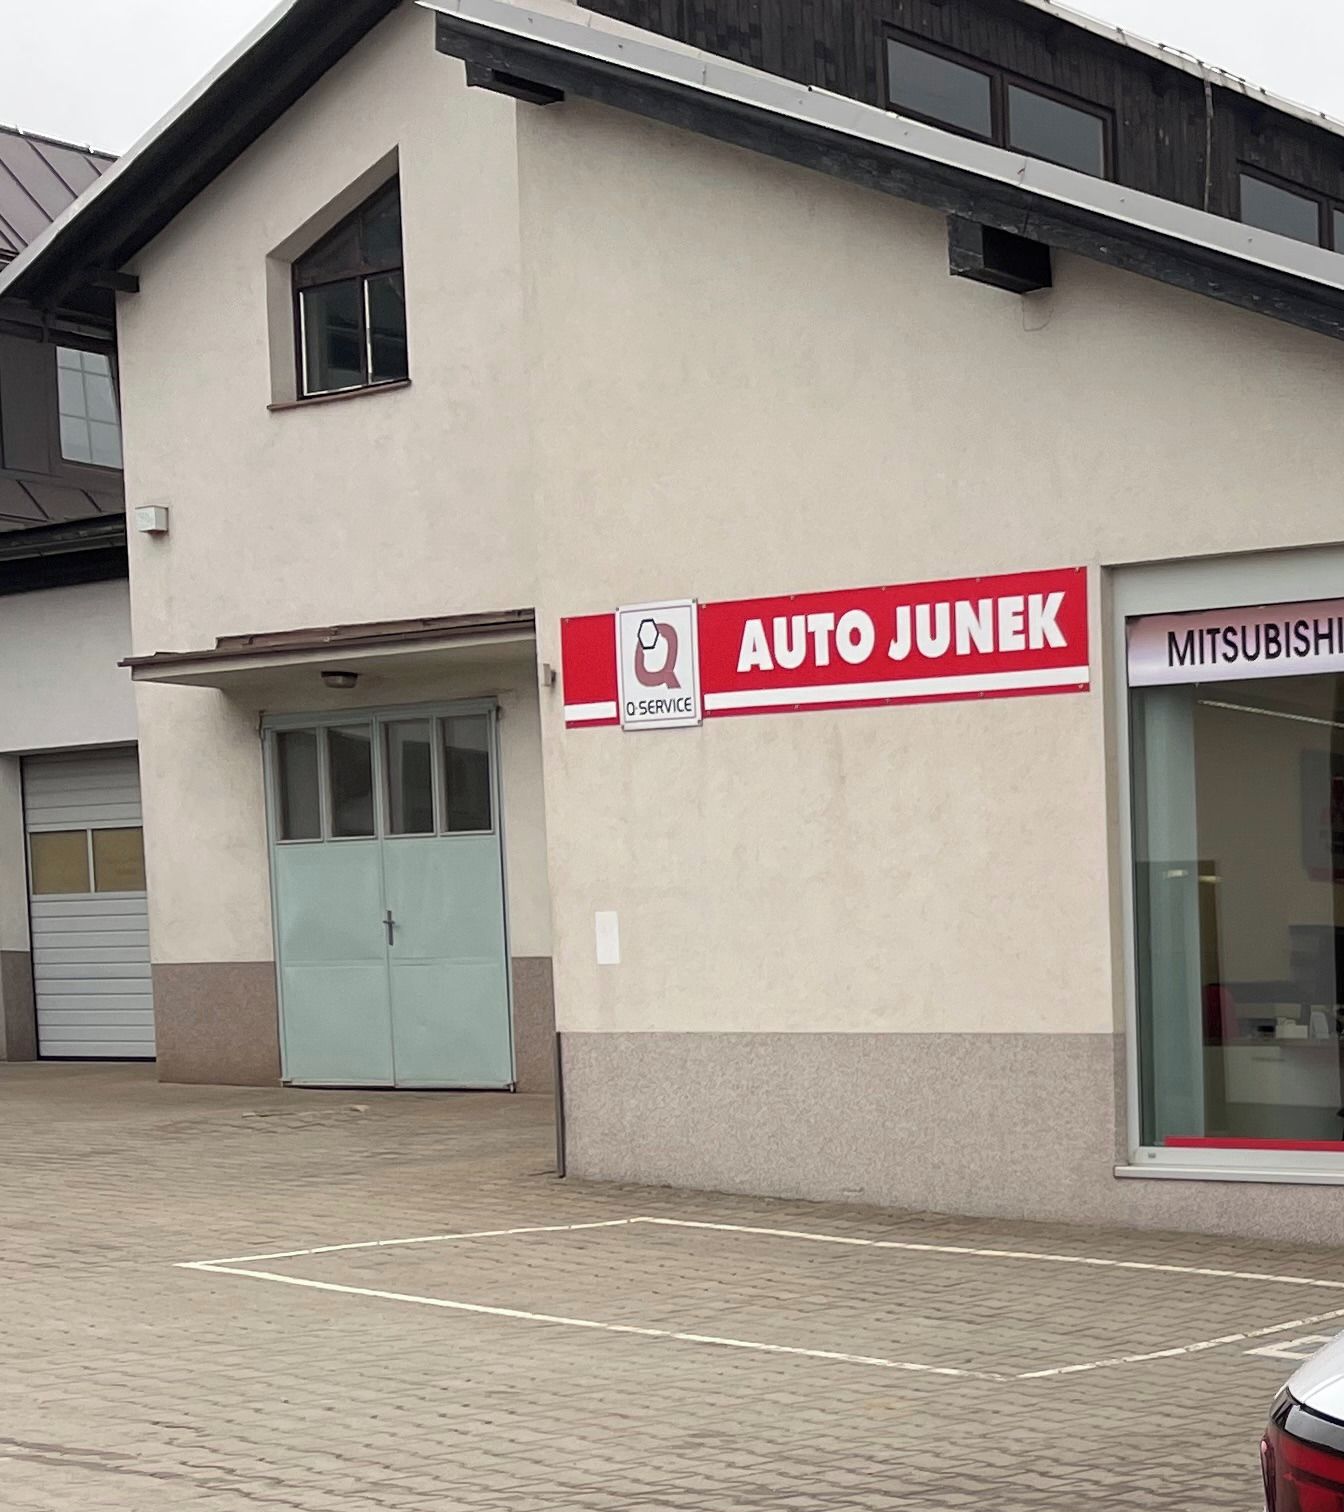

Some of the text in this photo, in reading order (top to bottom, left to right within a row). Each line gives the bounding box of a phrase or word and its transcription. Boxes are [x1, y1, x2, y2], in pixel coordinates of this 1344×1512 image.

[736, 592, 1067, 673] AUTO JUNEK
[1167, 617, 1344, 667] MITSUBISHI
